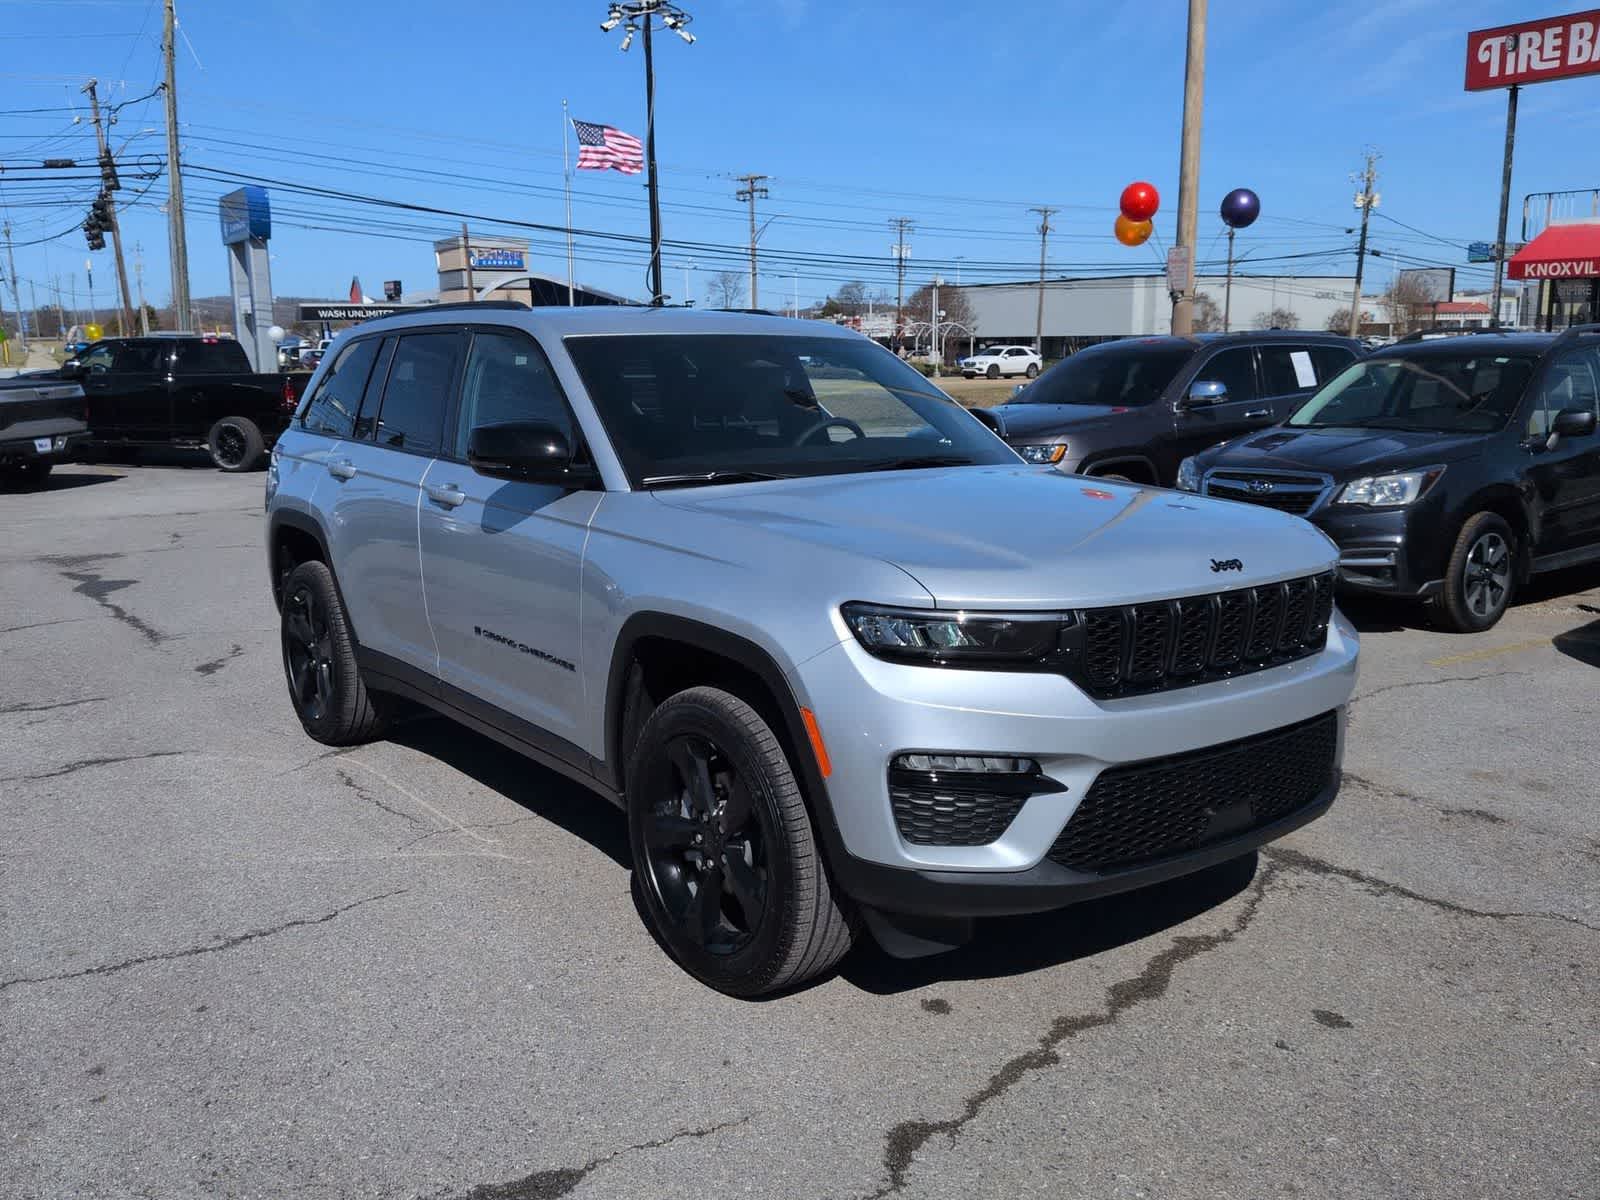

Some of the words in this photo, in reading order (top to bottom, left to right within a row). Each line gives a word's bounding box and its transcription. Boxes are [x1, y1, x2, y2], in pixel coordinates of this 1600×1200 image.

[1524, 261, 1599, 277] KNOXVIL
[318, 309, 346, 318] WASH
[347, 309, 395, 318] UNLIMITE
[1210, 558, 1243, 573] Jeep
